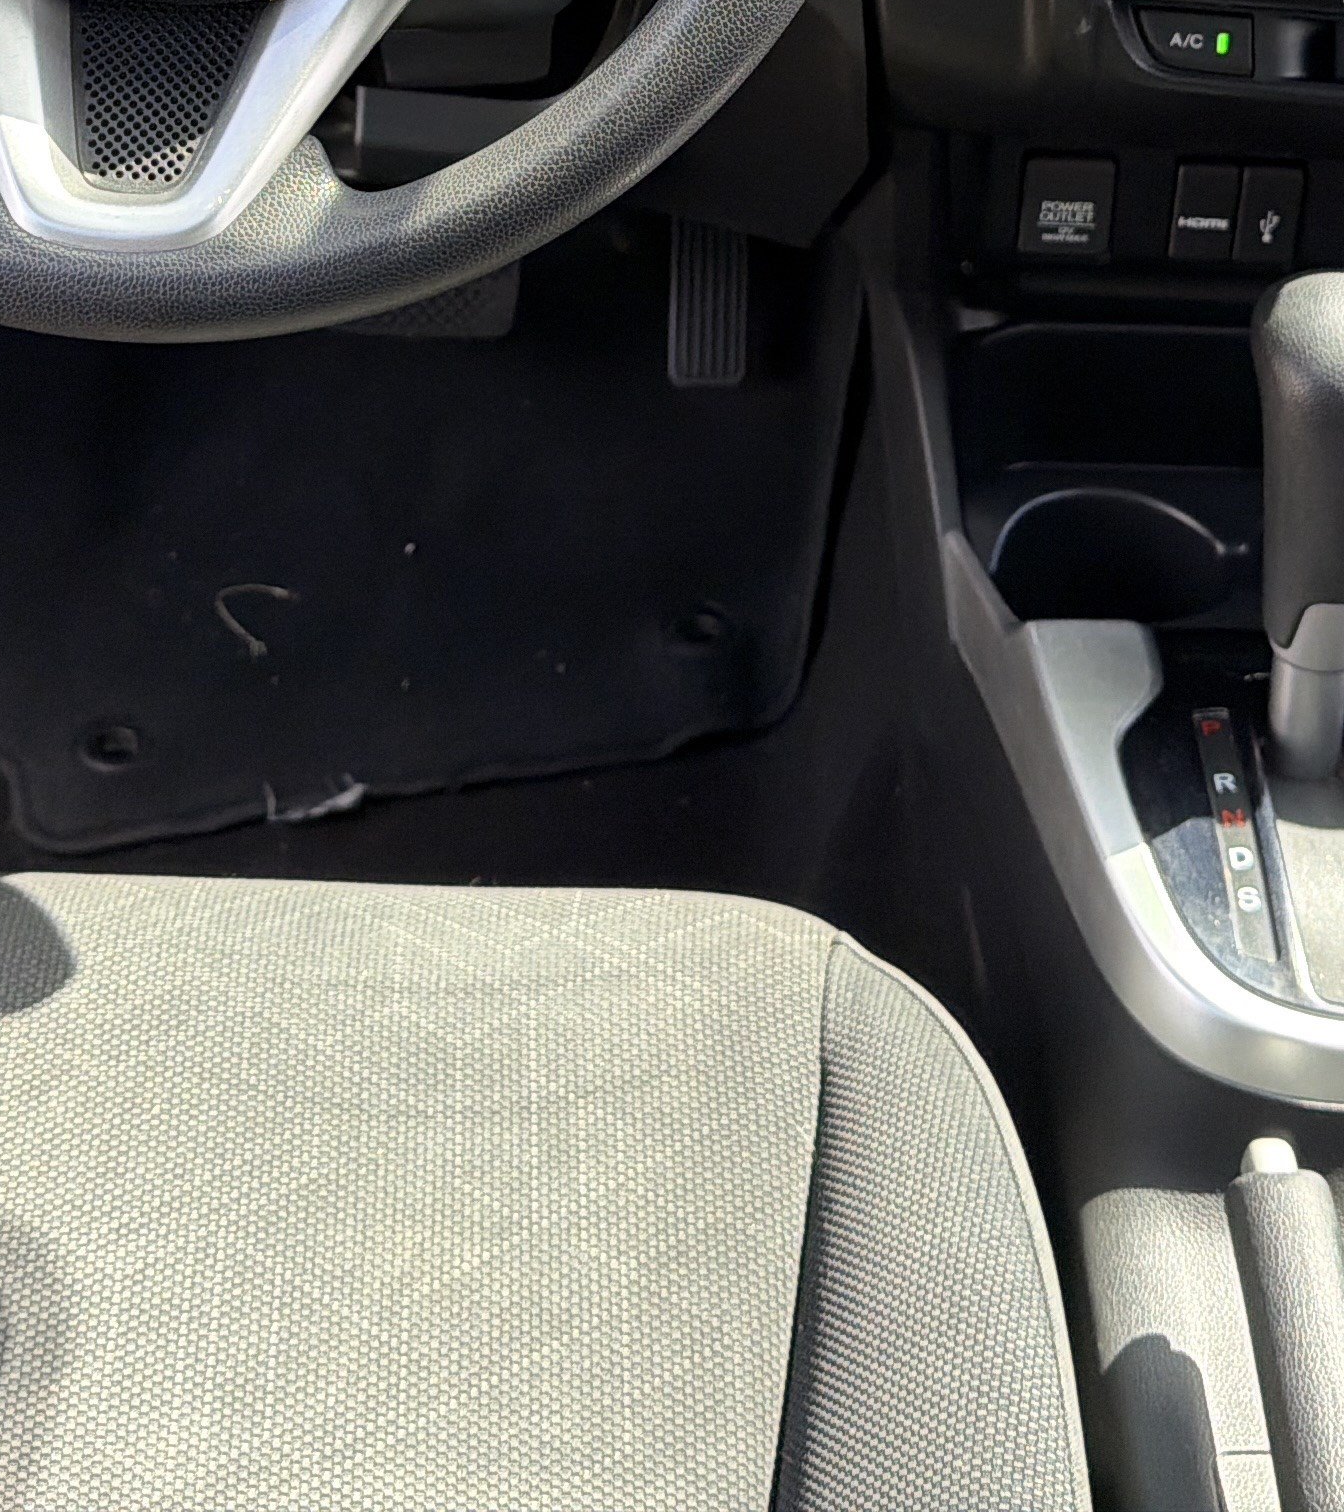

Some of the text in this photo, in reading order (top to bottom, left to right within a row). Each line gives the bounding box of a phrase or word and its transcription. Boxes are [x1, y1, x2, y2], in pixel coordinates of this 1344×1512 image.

[1169, 31, 1204, 50] A/C
[1041, 200, 1095, 212] POWER
[1039, 211, 1094, 222] OUTLET
[1202, 720, 1221, 737] P
[1213, 772, 1238, 794] R
[1222, 808, 1247, 829] N
[1228, 847, 1254, 871] D
[1237, 887, 1262, 914] S
